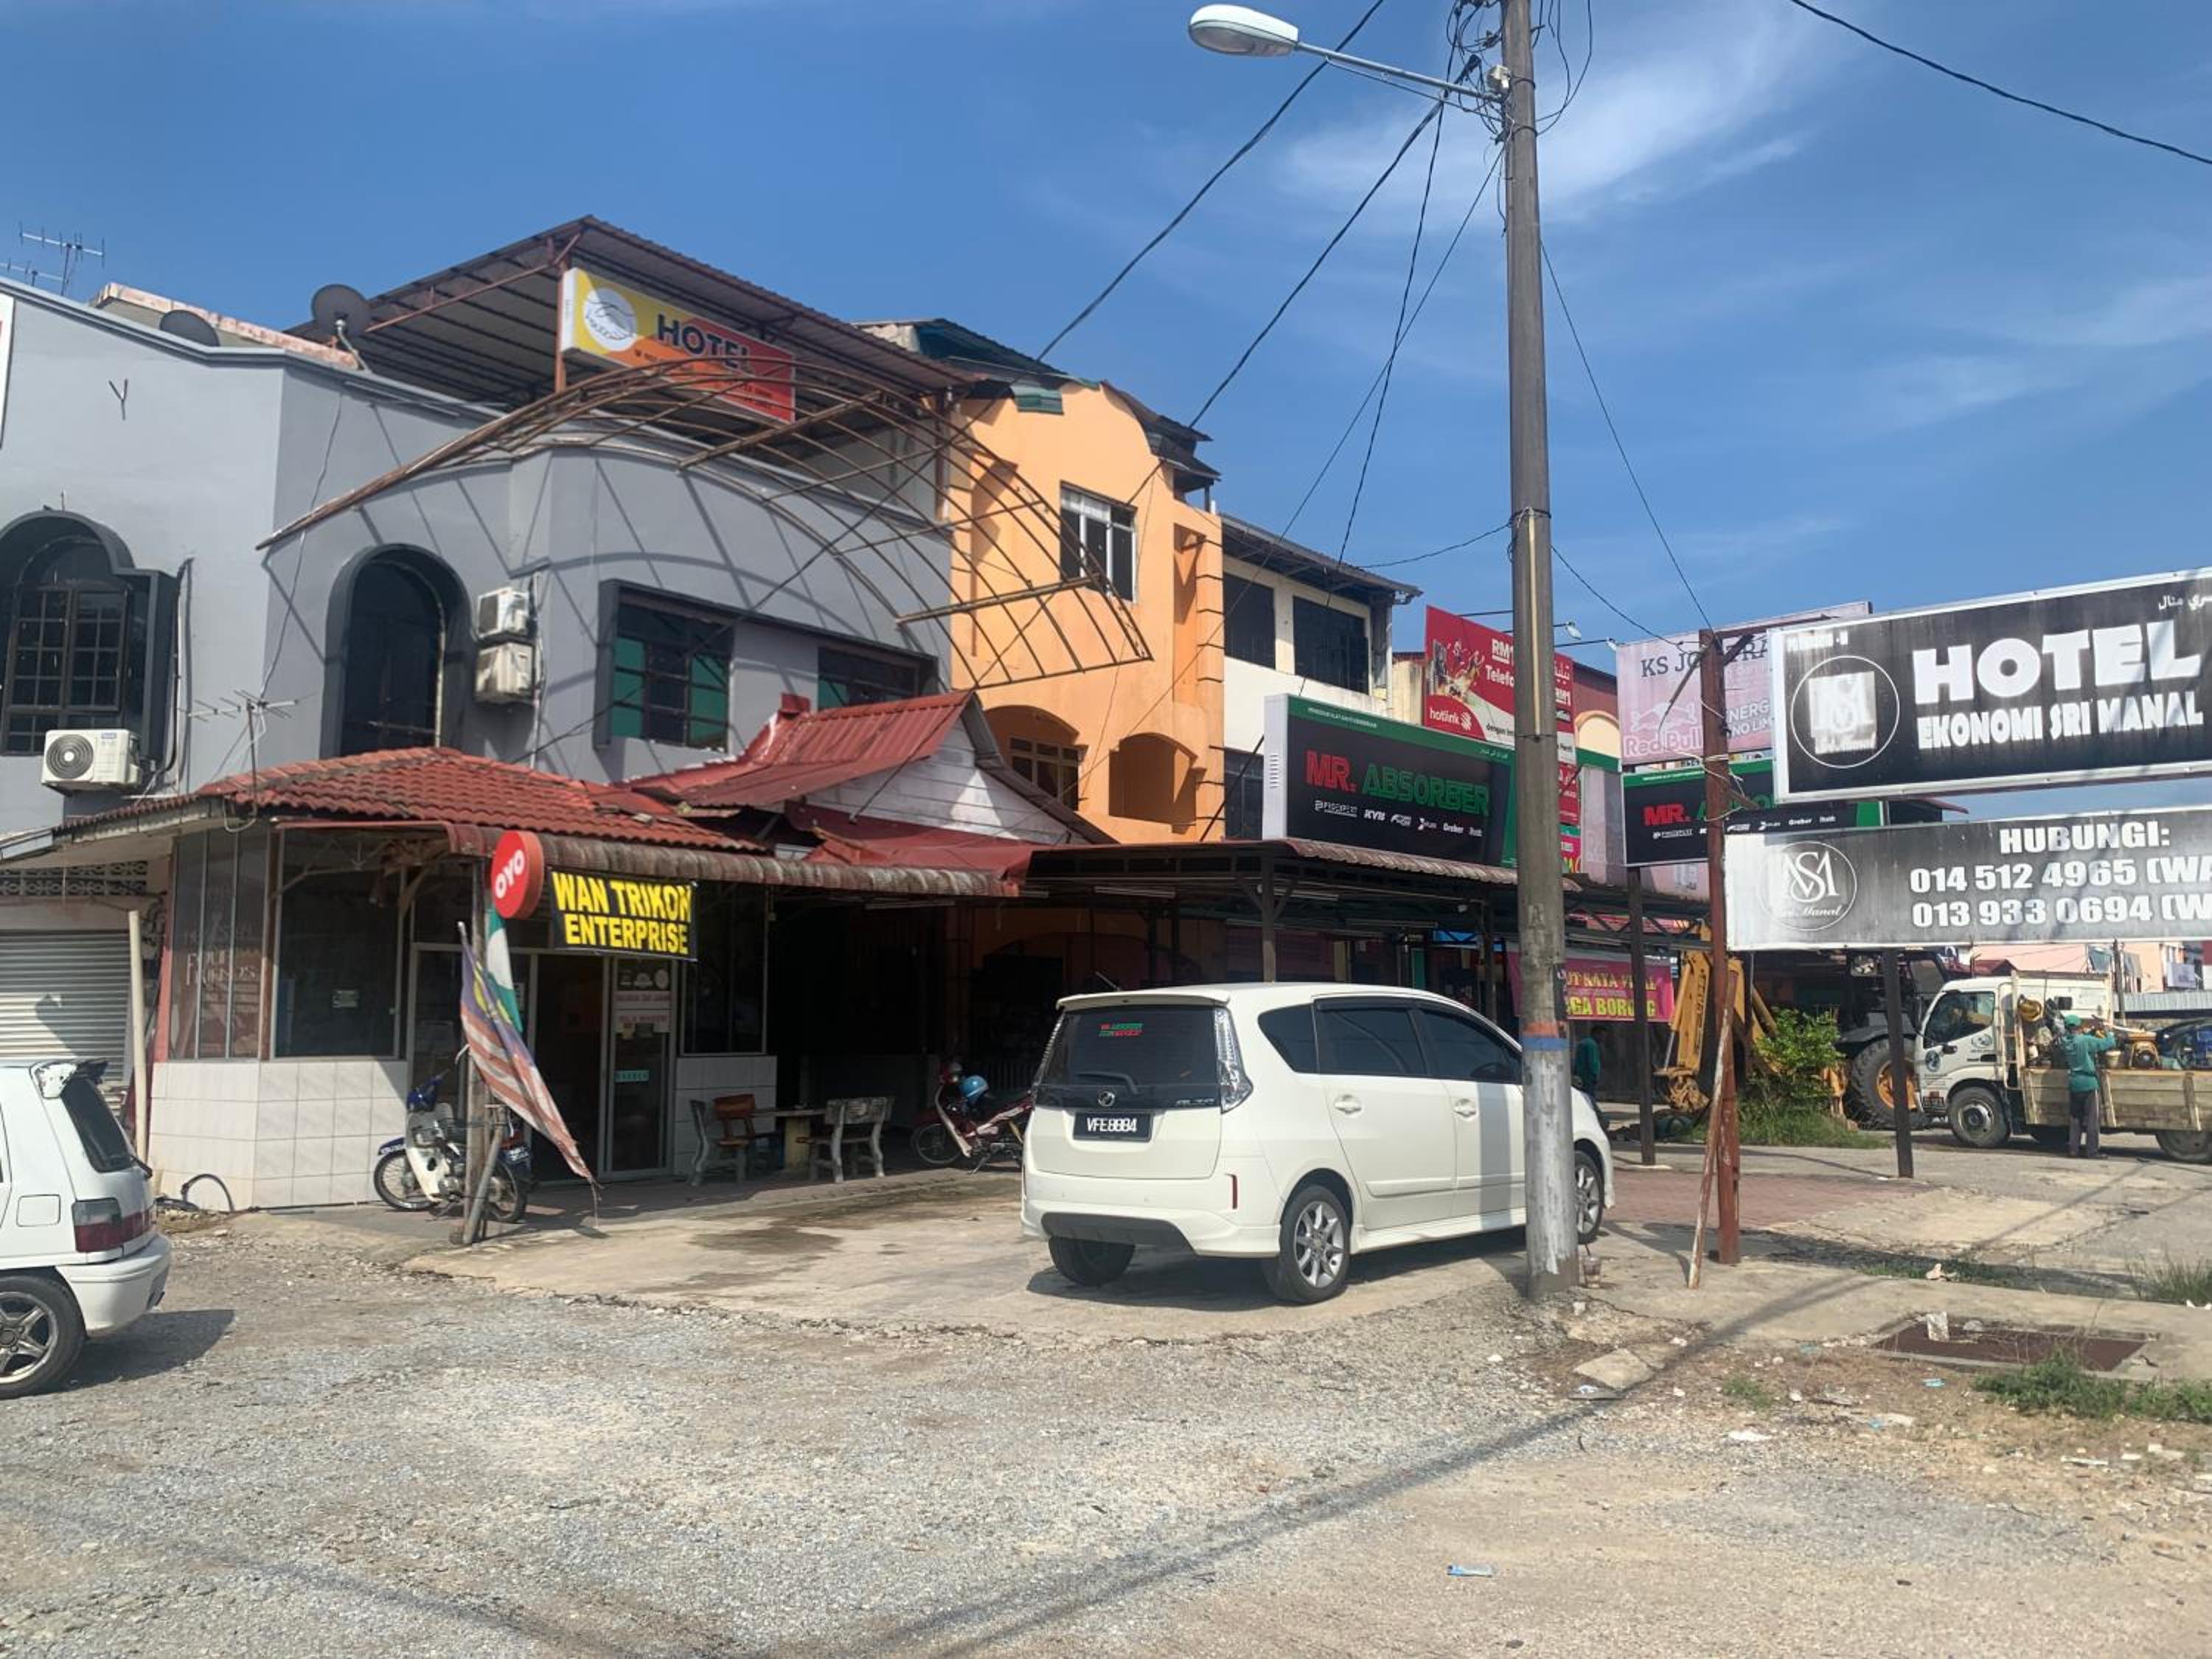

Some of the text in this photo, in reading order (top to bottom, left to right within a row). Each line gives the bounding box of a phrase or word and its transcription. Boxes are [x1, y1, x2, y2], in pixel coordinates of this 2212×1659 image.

[1641, 656, 1669, 677] KS
[1913, 619, 2201, 705] HOTEL
[1430, 707, 1461, 726] hotlink
[1916, 706, 2043, 750] EKONOMI
[2050, 701, 2092, 740] SRI
[2097, 691, 2204, 734] MANAL
[1624, 726, 1703, 758] Red Bull
[1305, 748, 1491, 816] MR. ABSORBER
[1643, 803, 1691, 827] MR.
[1999, 821, 2171, 855] HUBUNGI:
[495, 849, 525, 899] OYO
[1910, 866, 1968, 894] 014
[1975, 863, 2033, 891] 512
[2042, 859, 2137, 888] 4965
[552, 871, 692, 922] WAN TRIKON
[1912, 900, 1970, 928] 013
[1978, 899, 2046, 925] 933
[2056, 895, 2154, 923] 0694
[564, 914, 689, 955] ENTERPRISE
[1086, 1116, 1138, 1133] VFE8884
